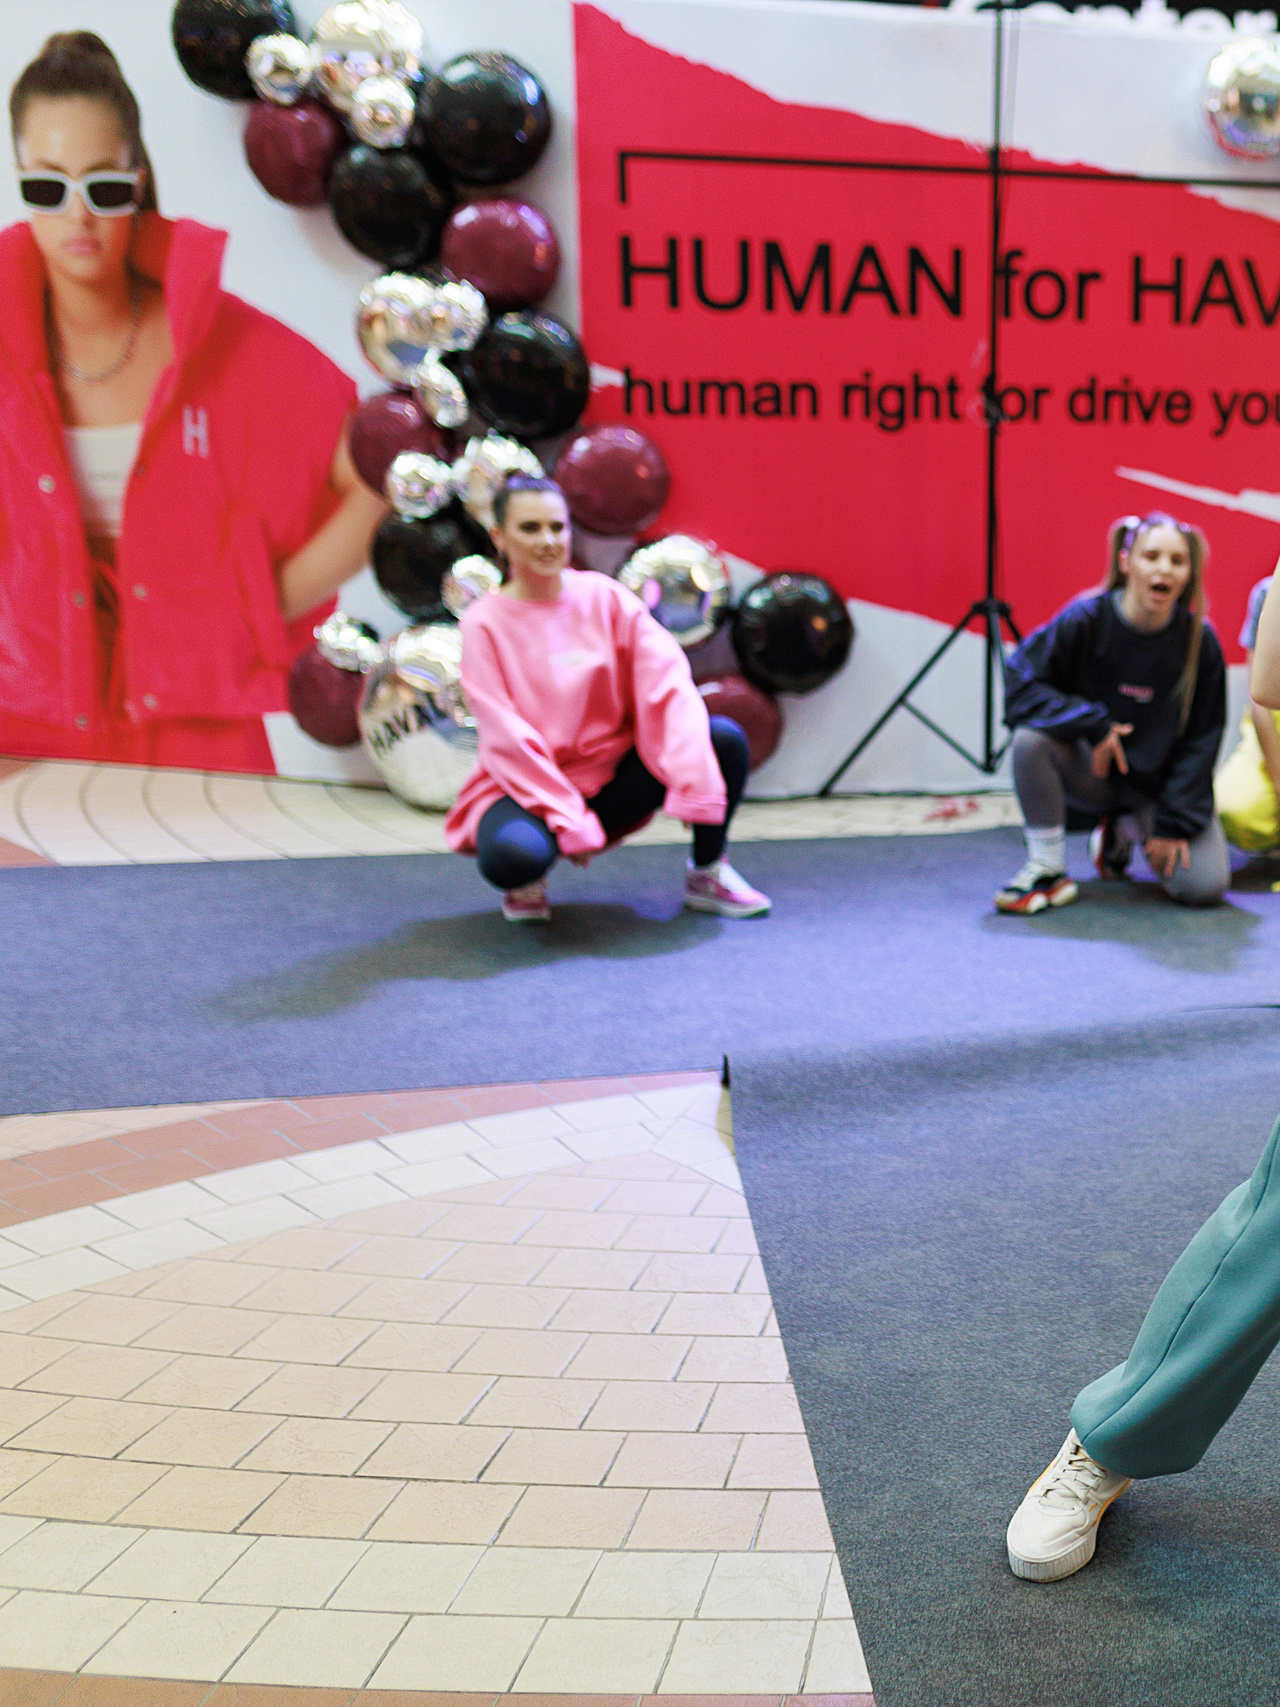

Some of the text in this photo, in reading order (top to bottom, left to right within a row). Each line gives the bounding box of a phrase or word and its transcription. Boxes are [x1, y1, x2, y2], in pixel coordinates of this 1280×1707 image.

[620, 235, 964, 318] HUMAN
[998, 249, 1102, 322] for
[624, 367, 818, 416] human
[844, 370, 961, 432] right
[984, 378, 1051, 422] or
[1069, 377, 1193, 424] drive
[367, 691, 449, 760] HAVAL
